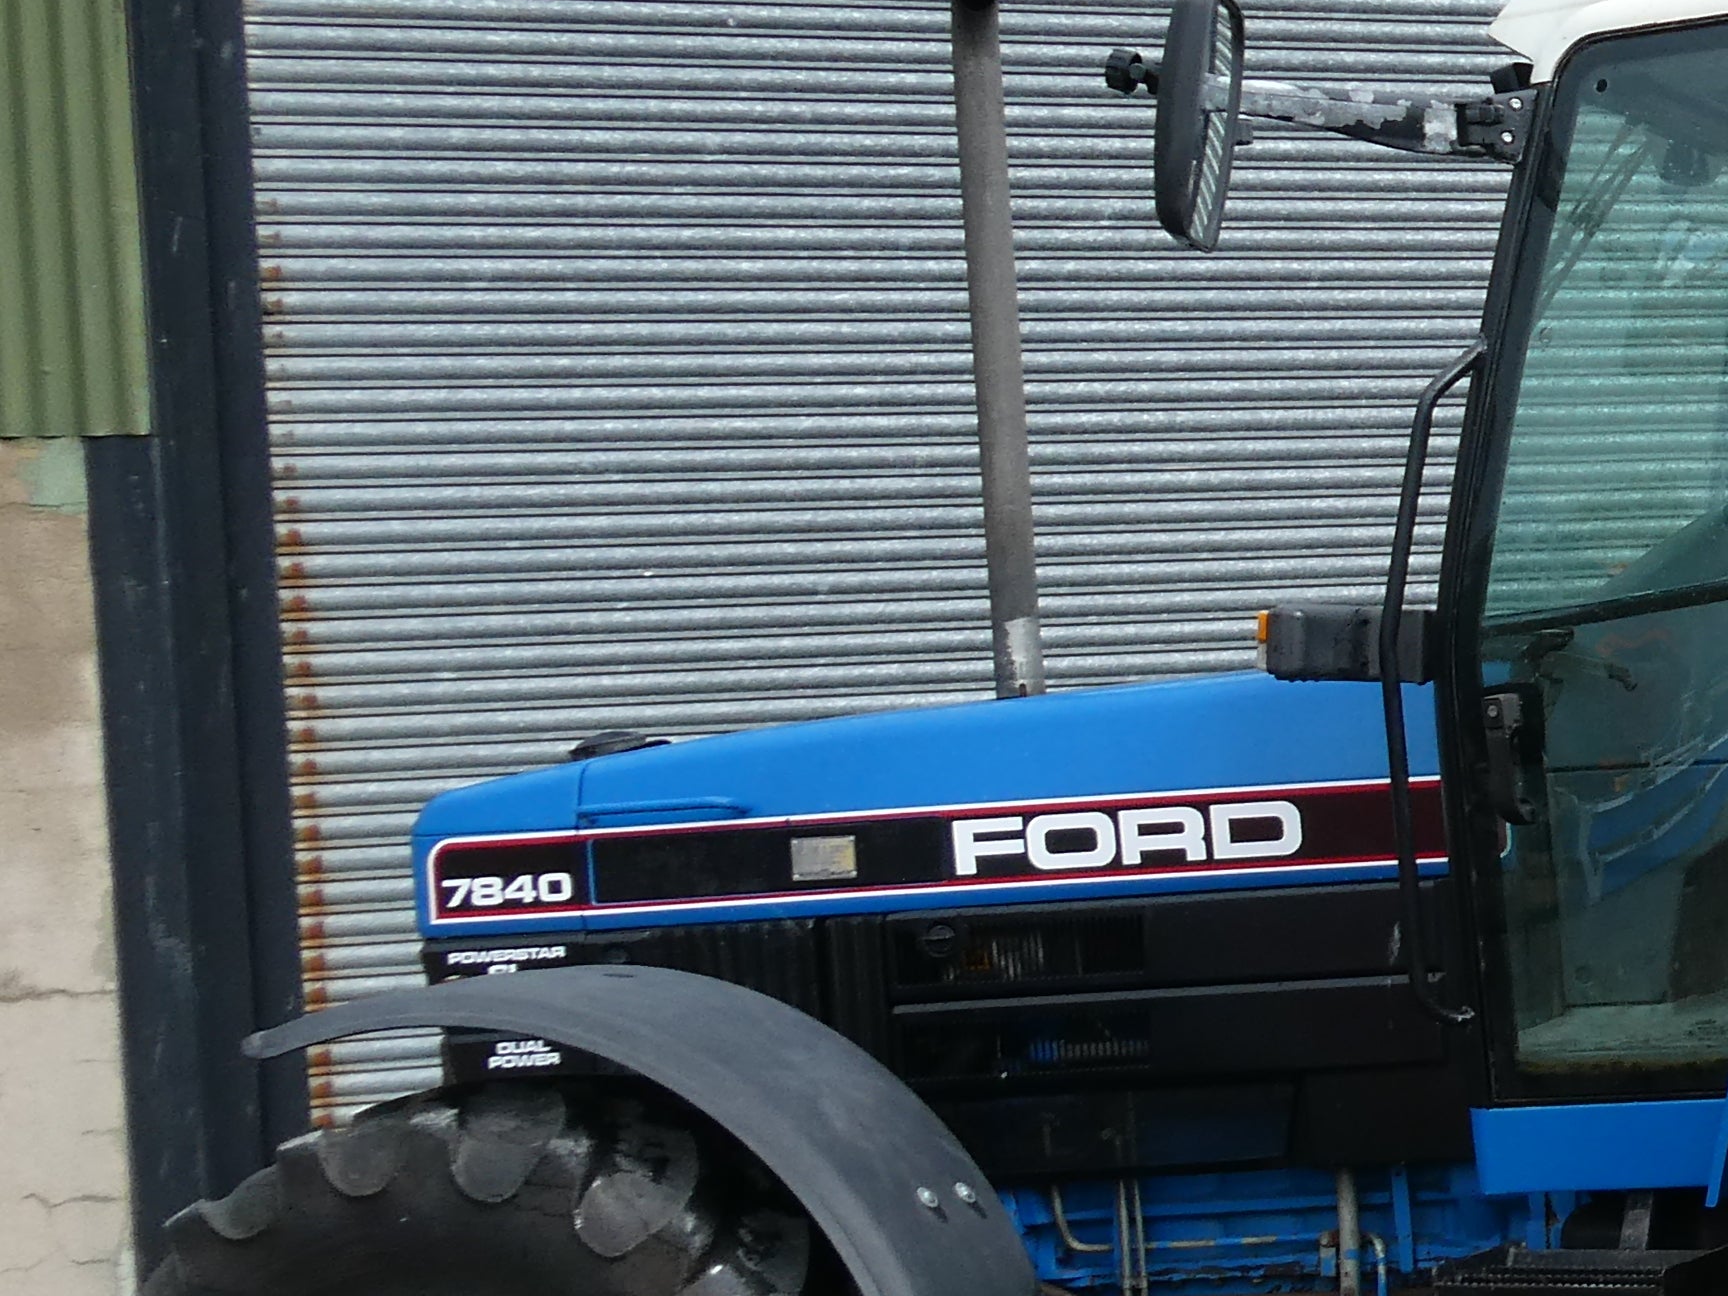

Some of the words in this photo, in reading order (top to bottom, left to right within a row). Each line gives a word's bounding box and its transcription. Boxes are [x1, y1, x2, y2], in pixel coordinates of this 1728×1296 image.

[952, 801, 1302, 876] FORD
[441, 872, 573, 908] 7840
[447, 946, 567, 965] POWERSTAR
[495, 1040, 553, 1055] DUAL
[488, 1052, 562, 1070] POWER
